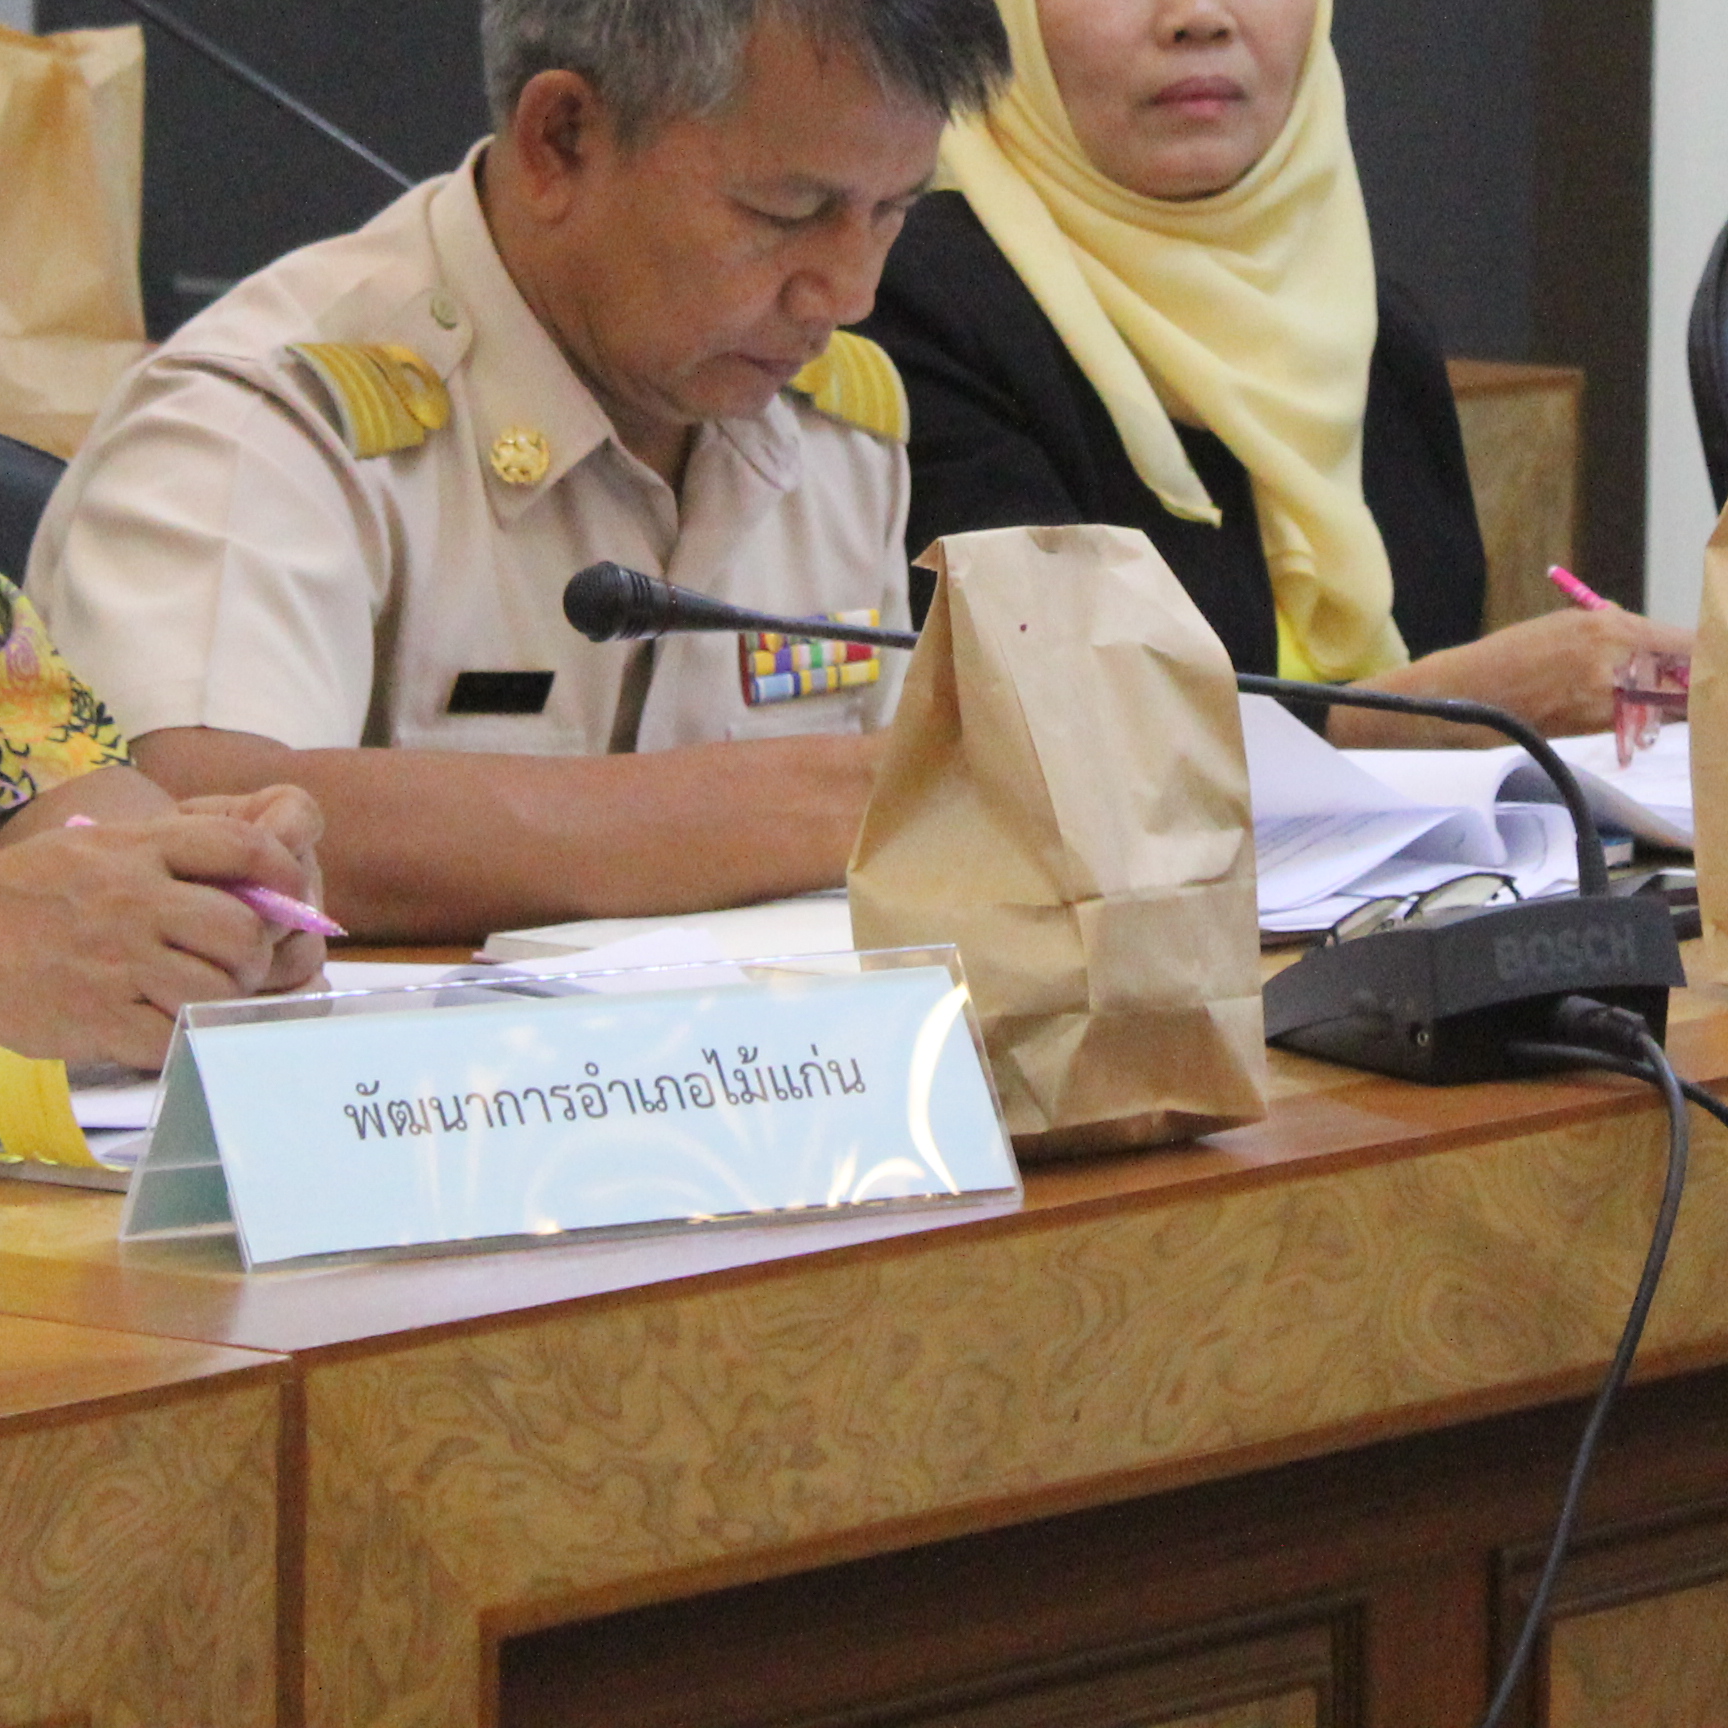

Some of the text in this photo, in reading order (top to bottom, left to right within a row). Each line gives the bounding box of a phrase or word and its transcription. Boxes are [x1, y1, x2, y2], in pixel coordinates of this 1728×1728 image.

[1493, 923, 1637, 981] BOSCH
[342, 1043, 867, 1142] พัฒนาการอำเภอไม้แก่น
